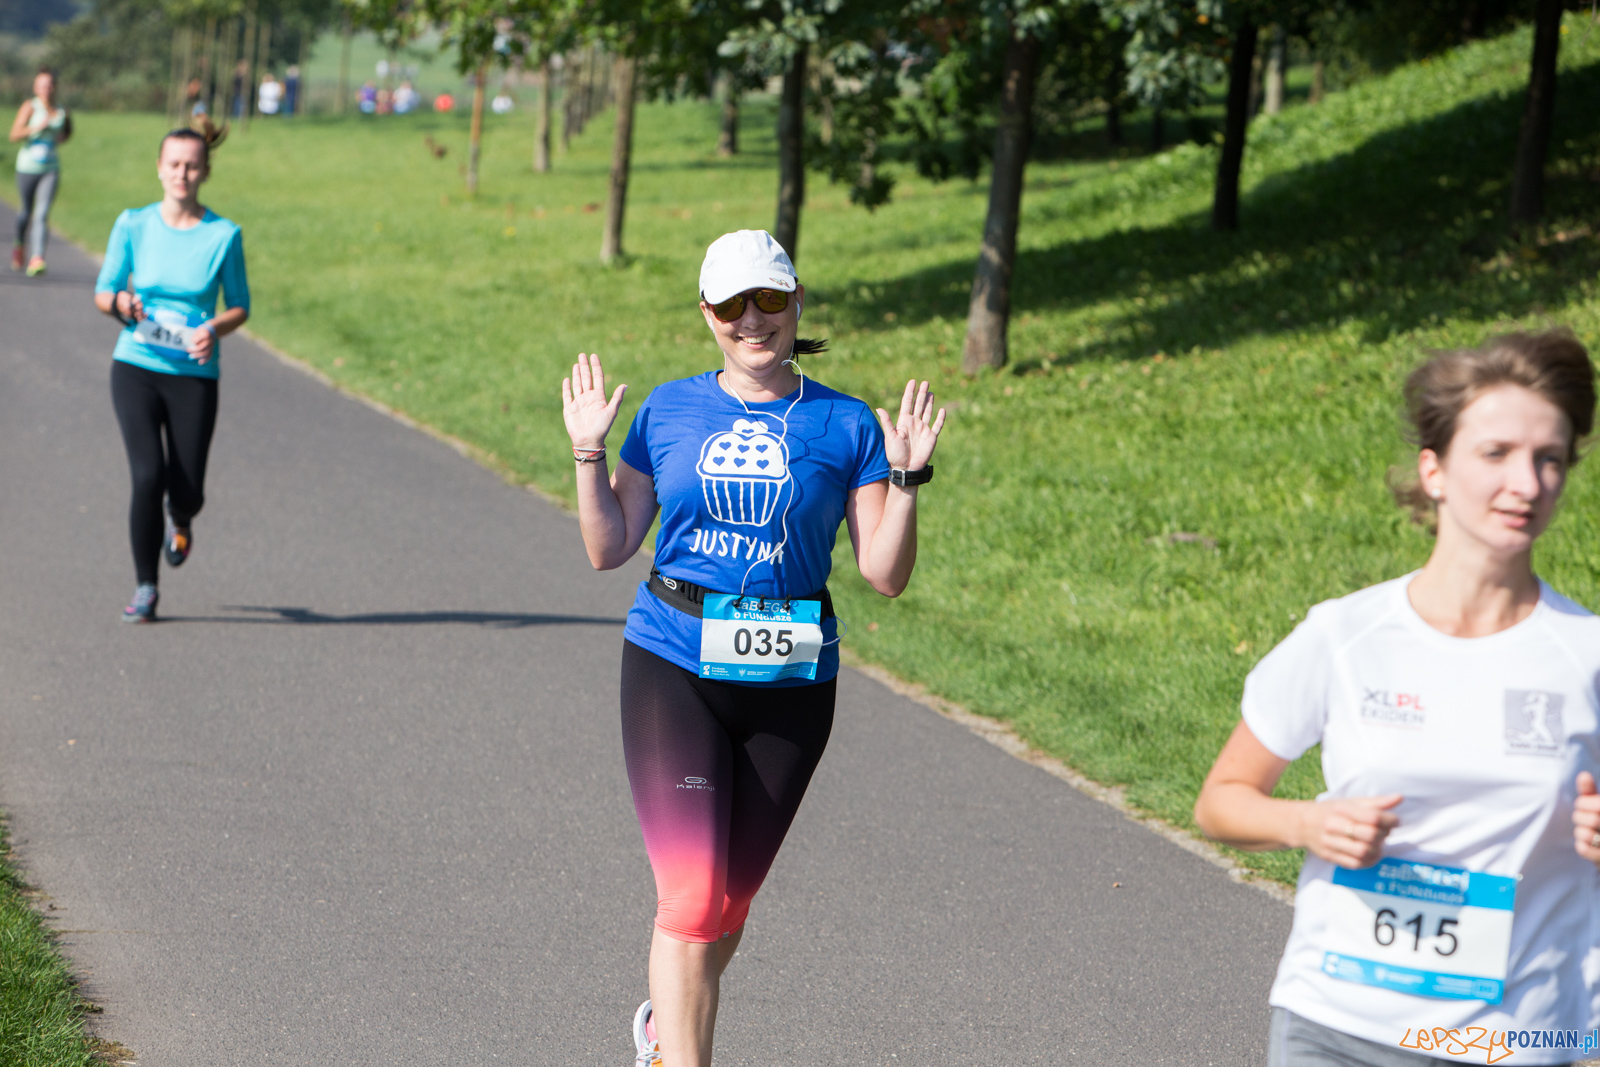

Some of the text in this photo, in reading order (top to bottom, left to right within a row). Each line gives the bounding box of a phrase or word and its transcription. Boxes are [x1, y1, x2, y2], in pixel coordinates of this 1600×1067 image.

[689, 528, 784, 565] JUSTYNA
[734, 628, 793, 656] 035
[1374, 909, 1459, 956] 615
